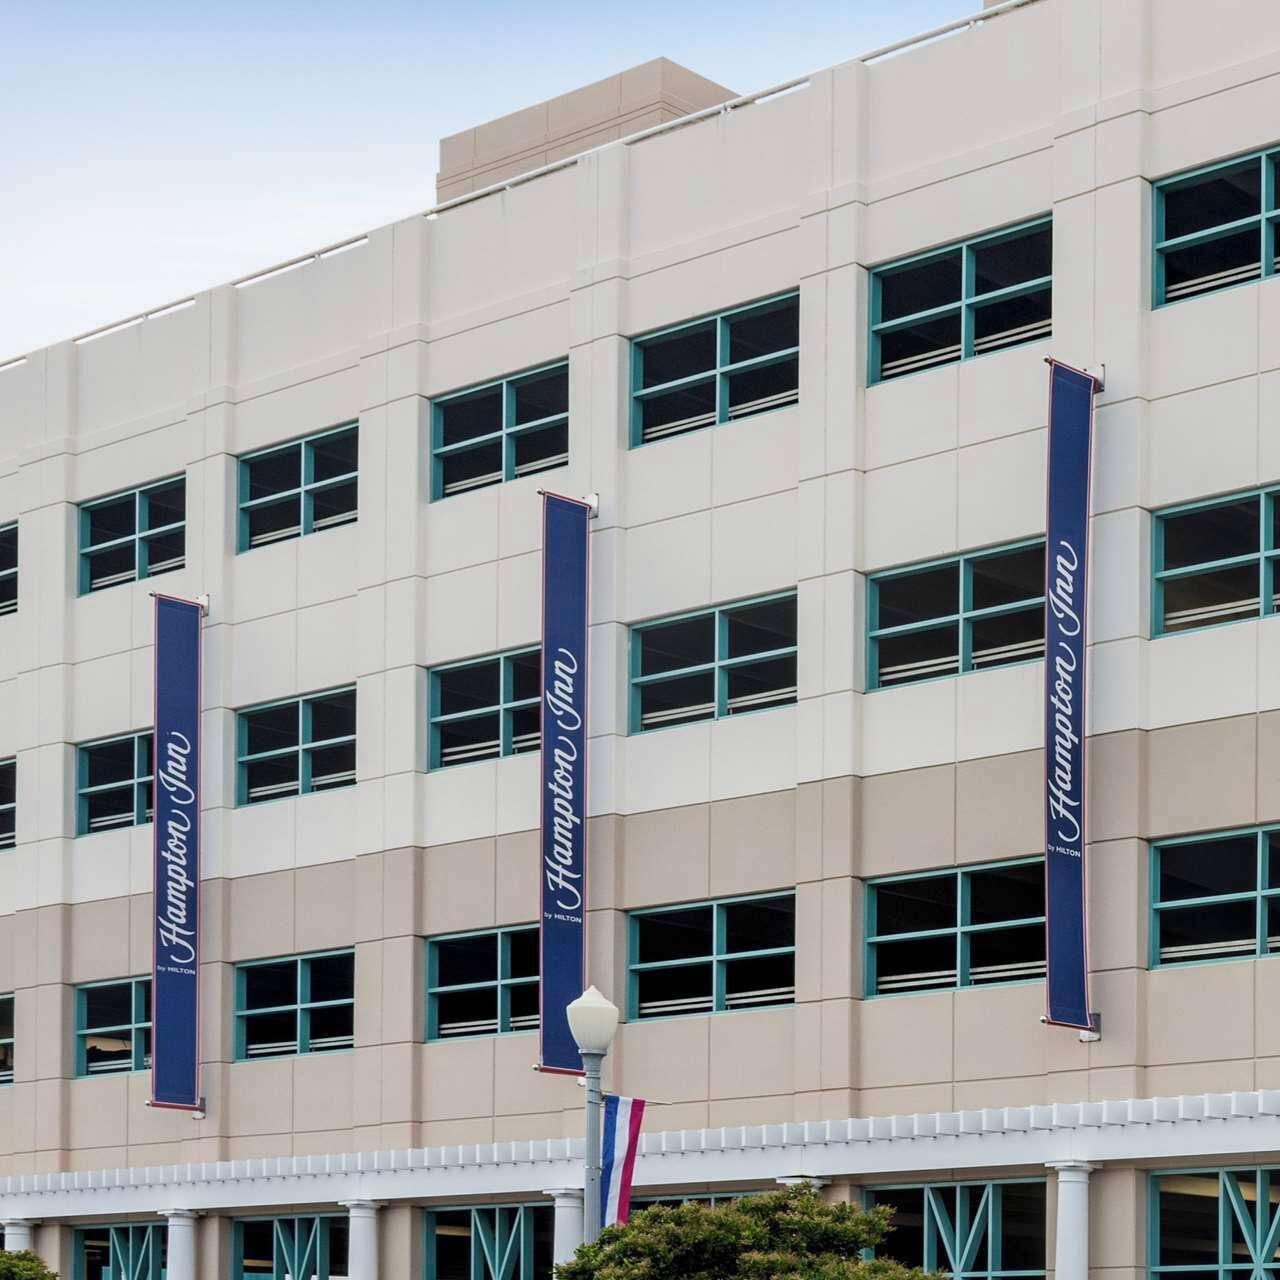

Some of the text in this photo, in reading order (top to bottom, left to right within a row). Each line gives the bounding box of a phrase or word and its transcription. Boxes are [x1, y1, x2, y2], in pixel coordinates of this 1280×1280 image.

[1048, 540, 1080, 842] Hampton Inn
[545, 647, 582, 910] Hampton Inn
[158, 731, 195, 963] Hampton Inn
[1056, 846, 1081, 858] HILTON
[167, 966, 196, 976] HILTON
[554, 913, 582, 923] HILTON
